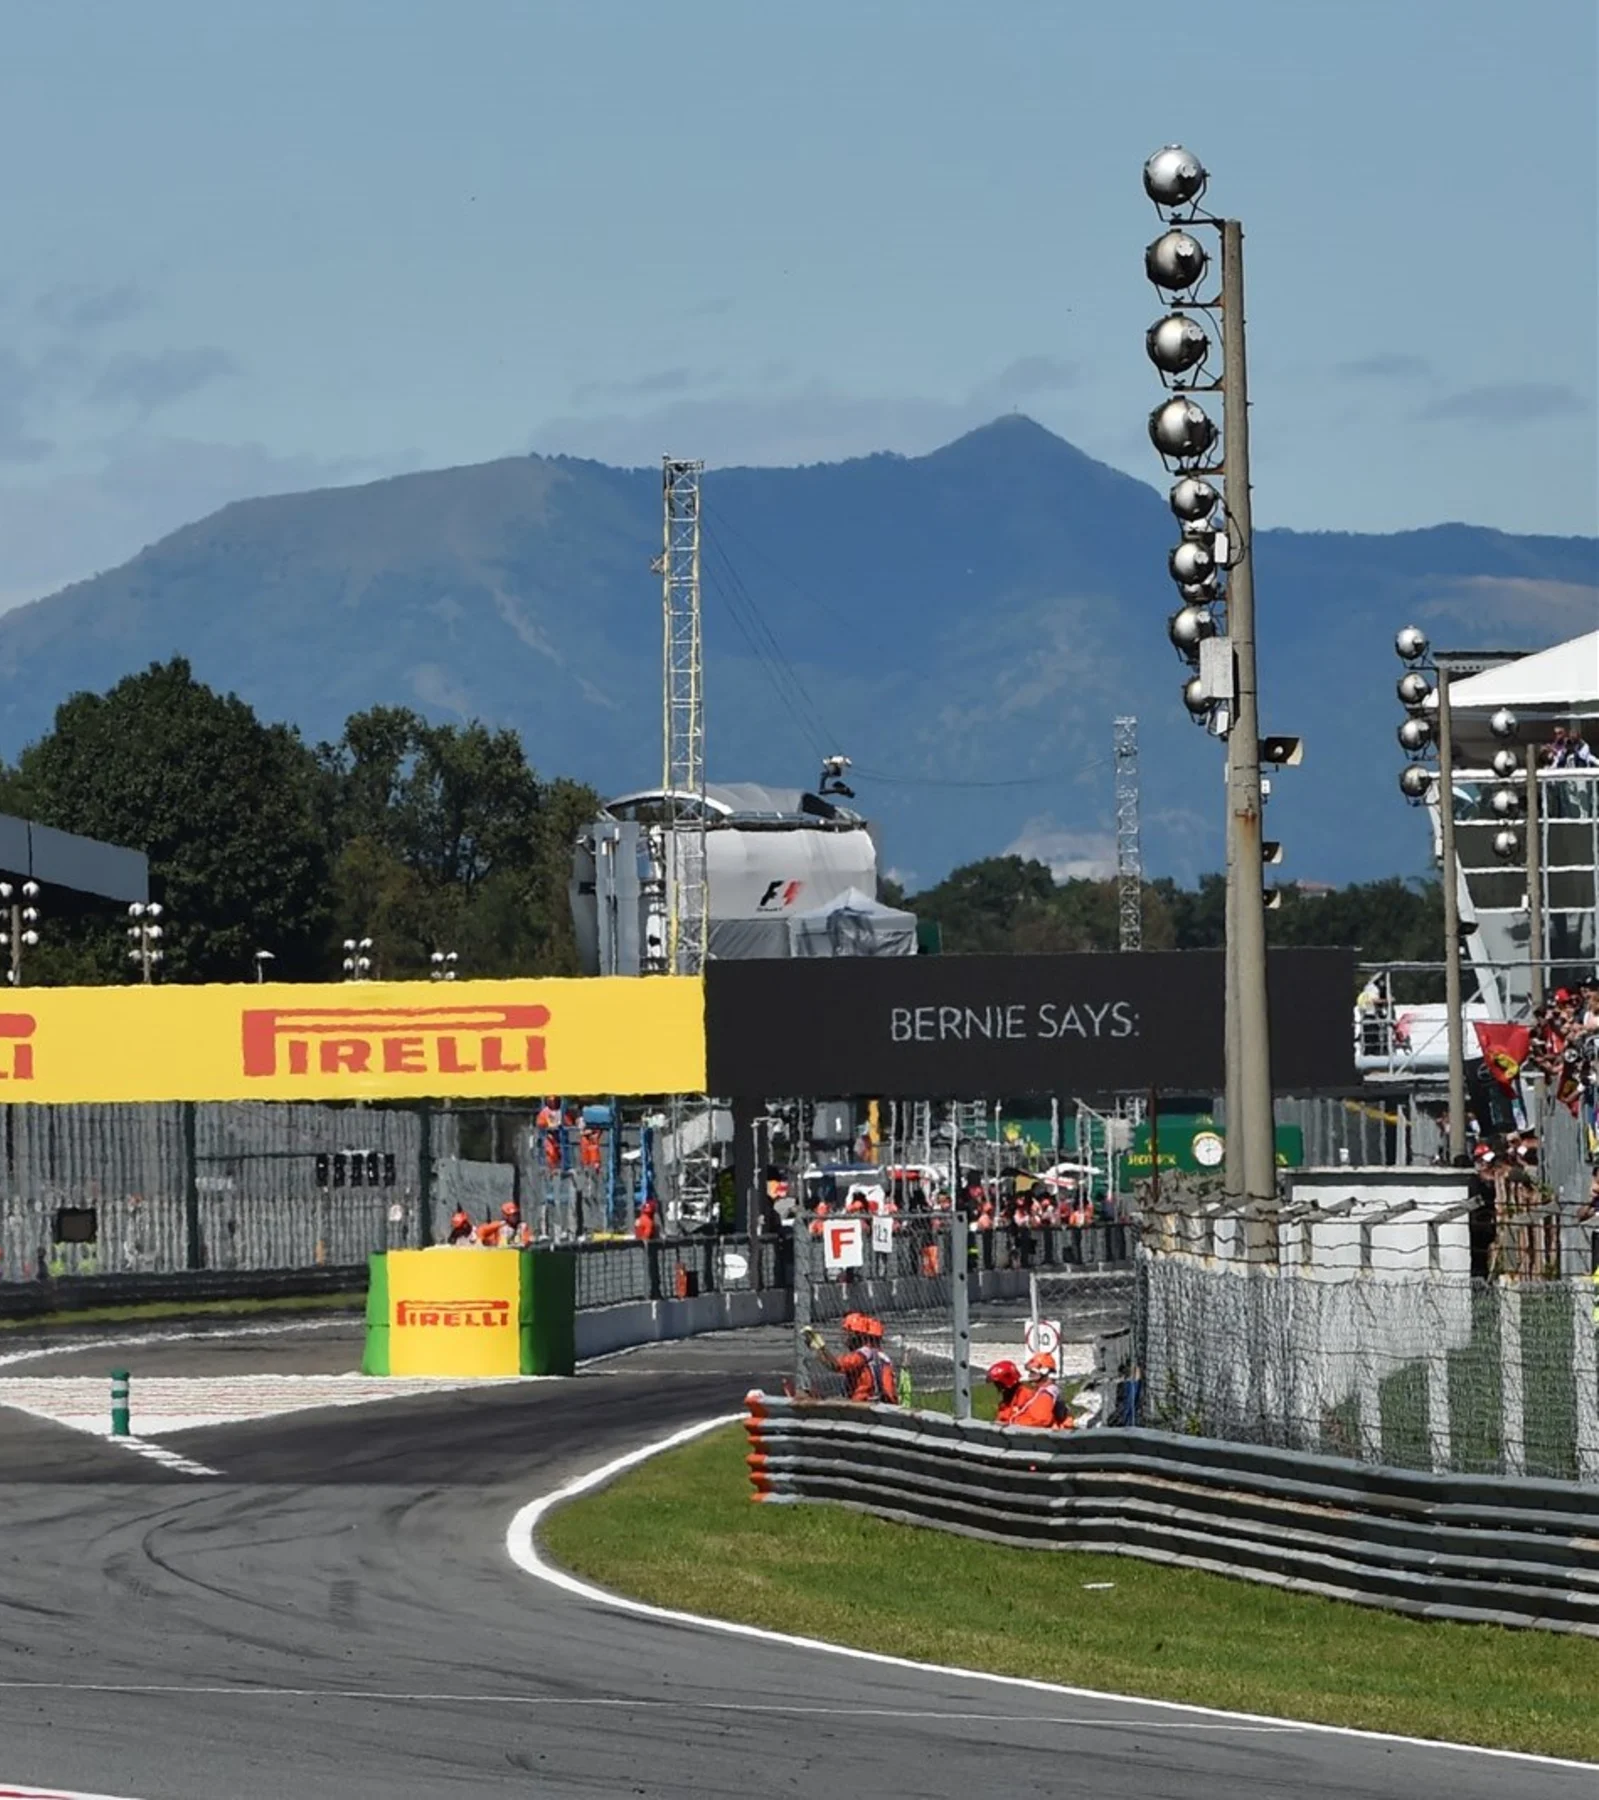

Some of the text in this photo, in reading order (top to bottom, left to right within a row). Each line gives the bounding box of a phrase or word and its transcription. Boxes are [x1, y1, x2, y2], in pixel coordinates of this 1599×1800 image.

[891, 1001, 1140, 1041] BERNIE SAYS:
[242, 1005, 551, 1077] PIRELLI
[831, 1227, 855, 1259] F
[396, 1300, 510, 1328] PIRELLI
